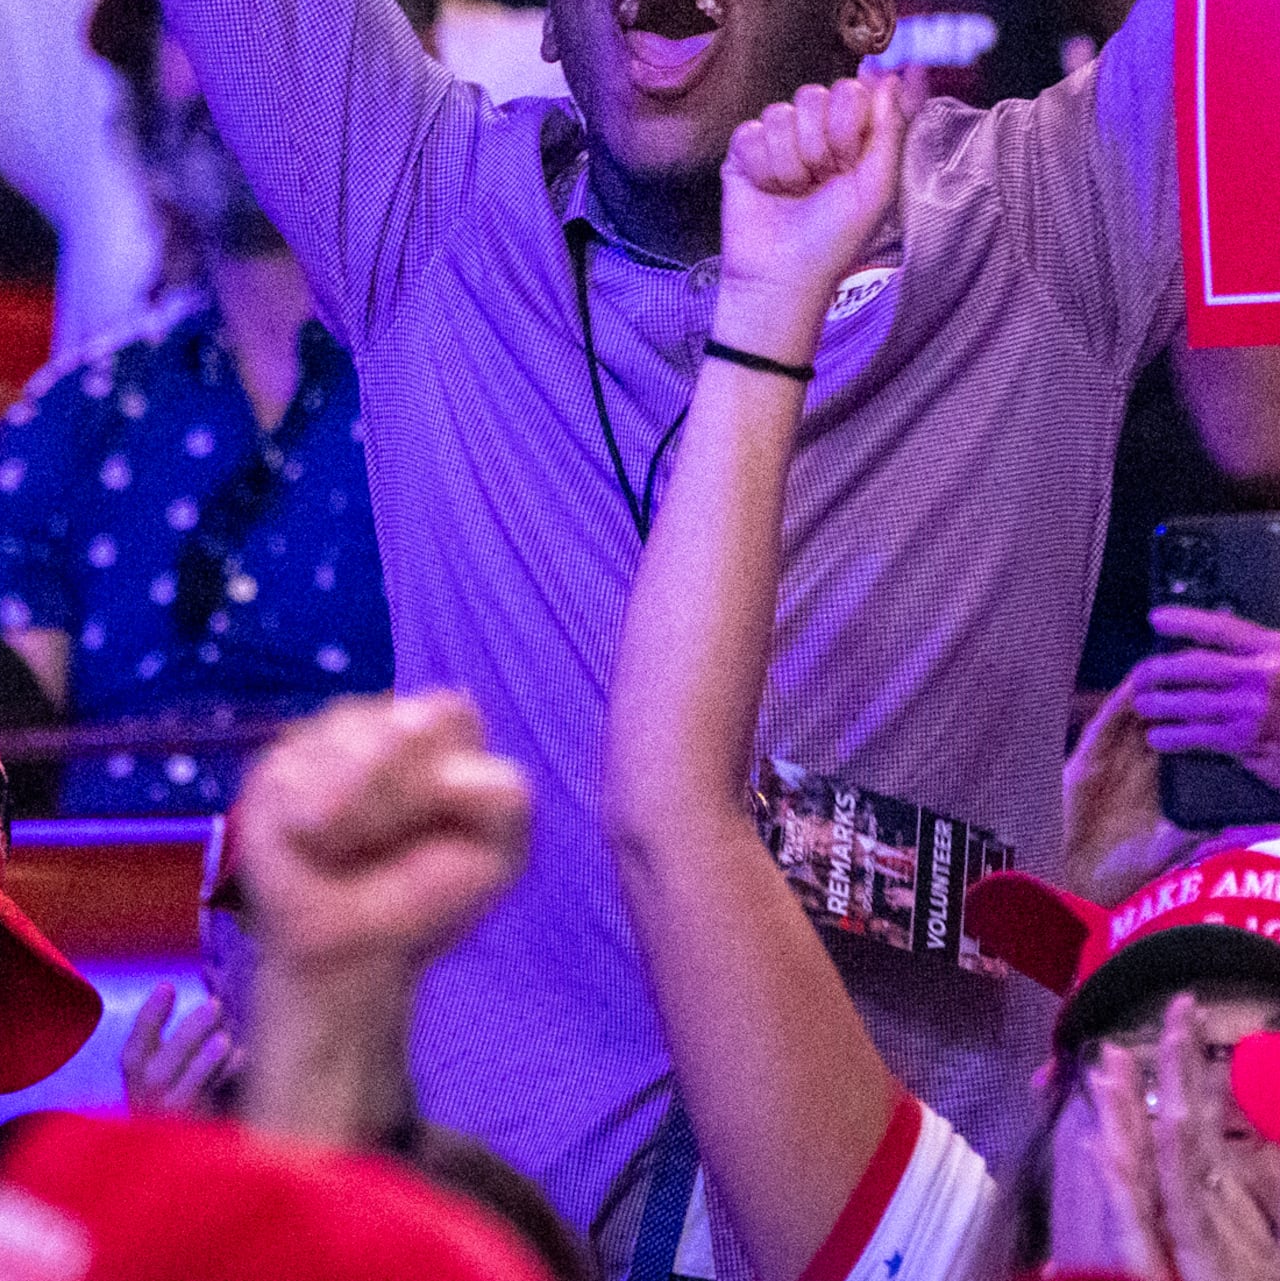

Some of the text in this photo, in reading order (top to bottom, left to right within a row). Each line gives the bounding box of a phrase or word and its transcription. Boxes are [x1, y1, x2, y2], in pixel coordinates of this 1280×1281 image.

[827, 790, 856, 916] REMARKS
[927, 818, 953, 950] VOLUNTEER
[1109, 871, 1204, 951] MAKE
